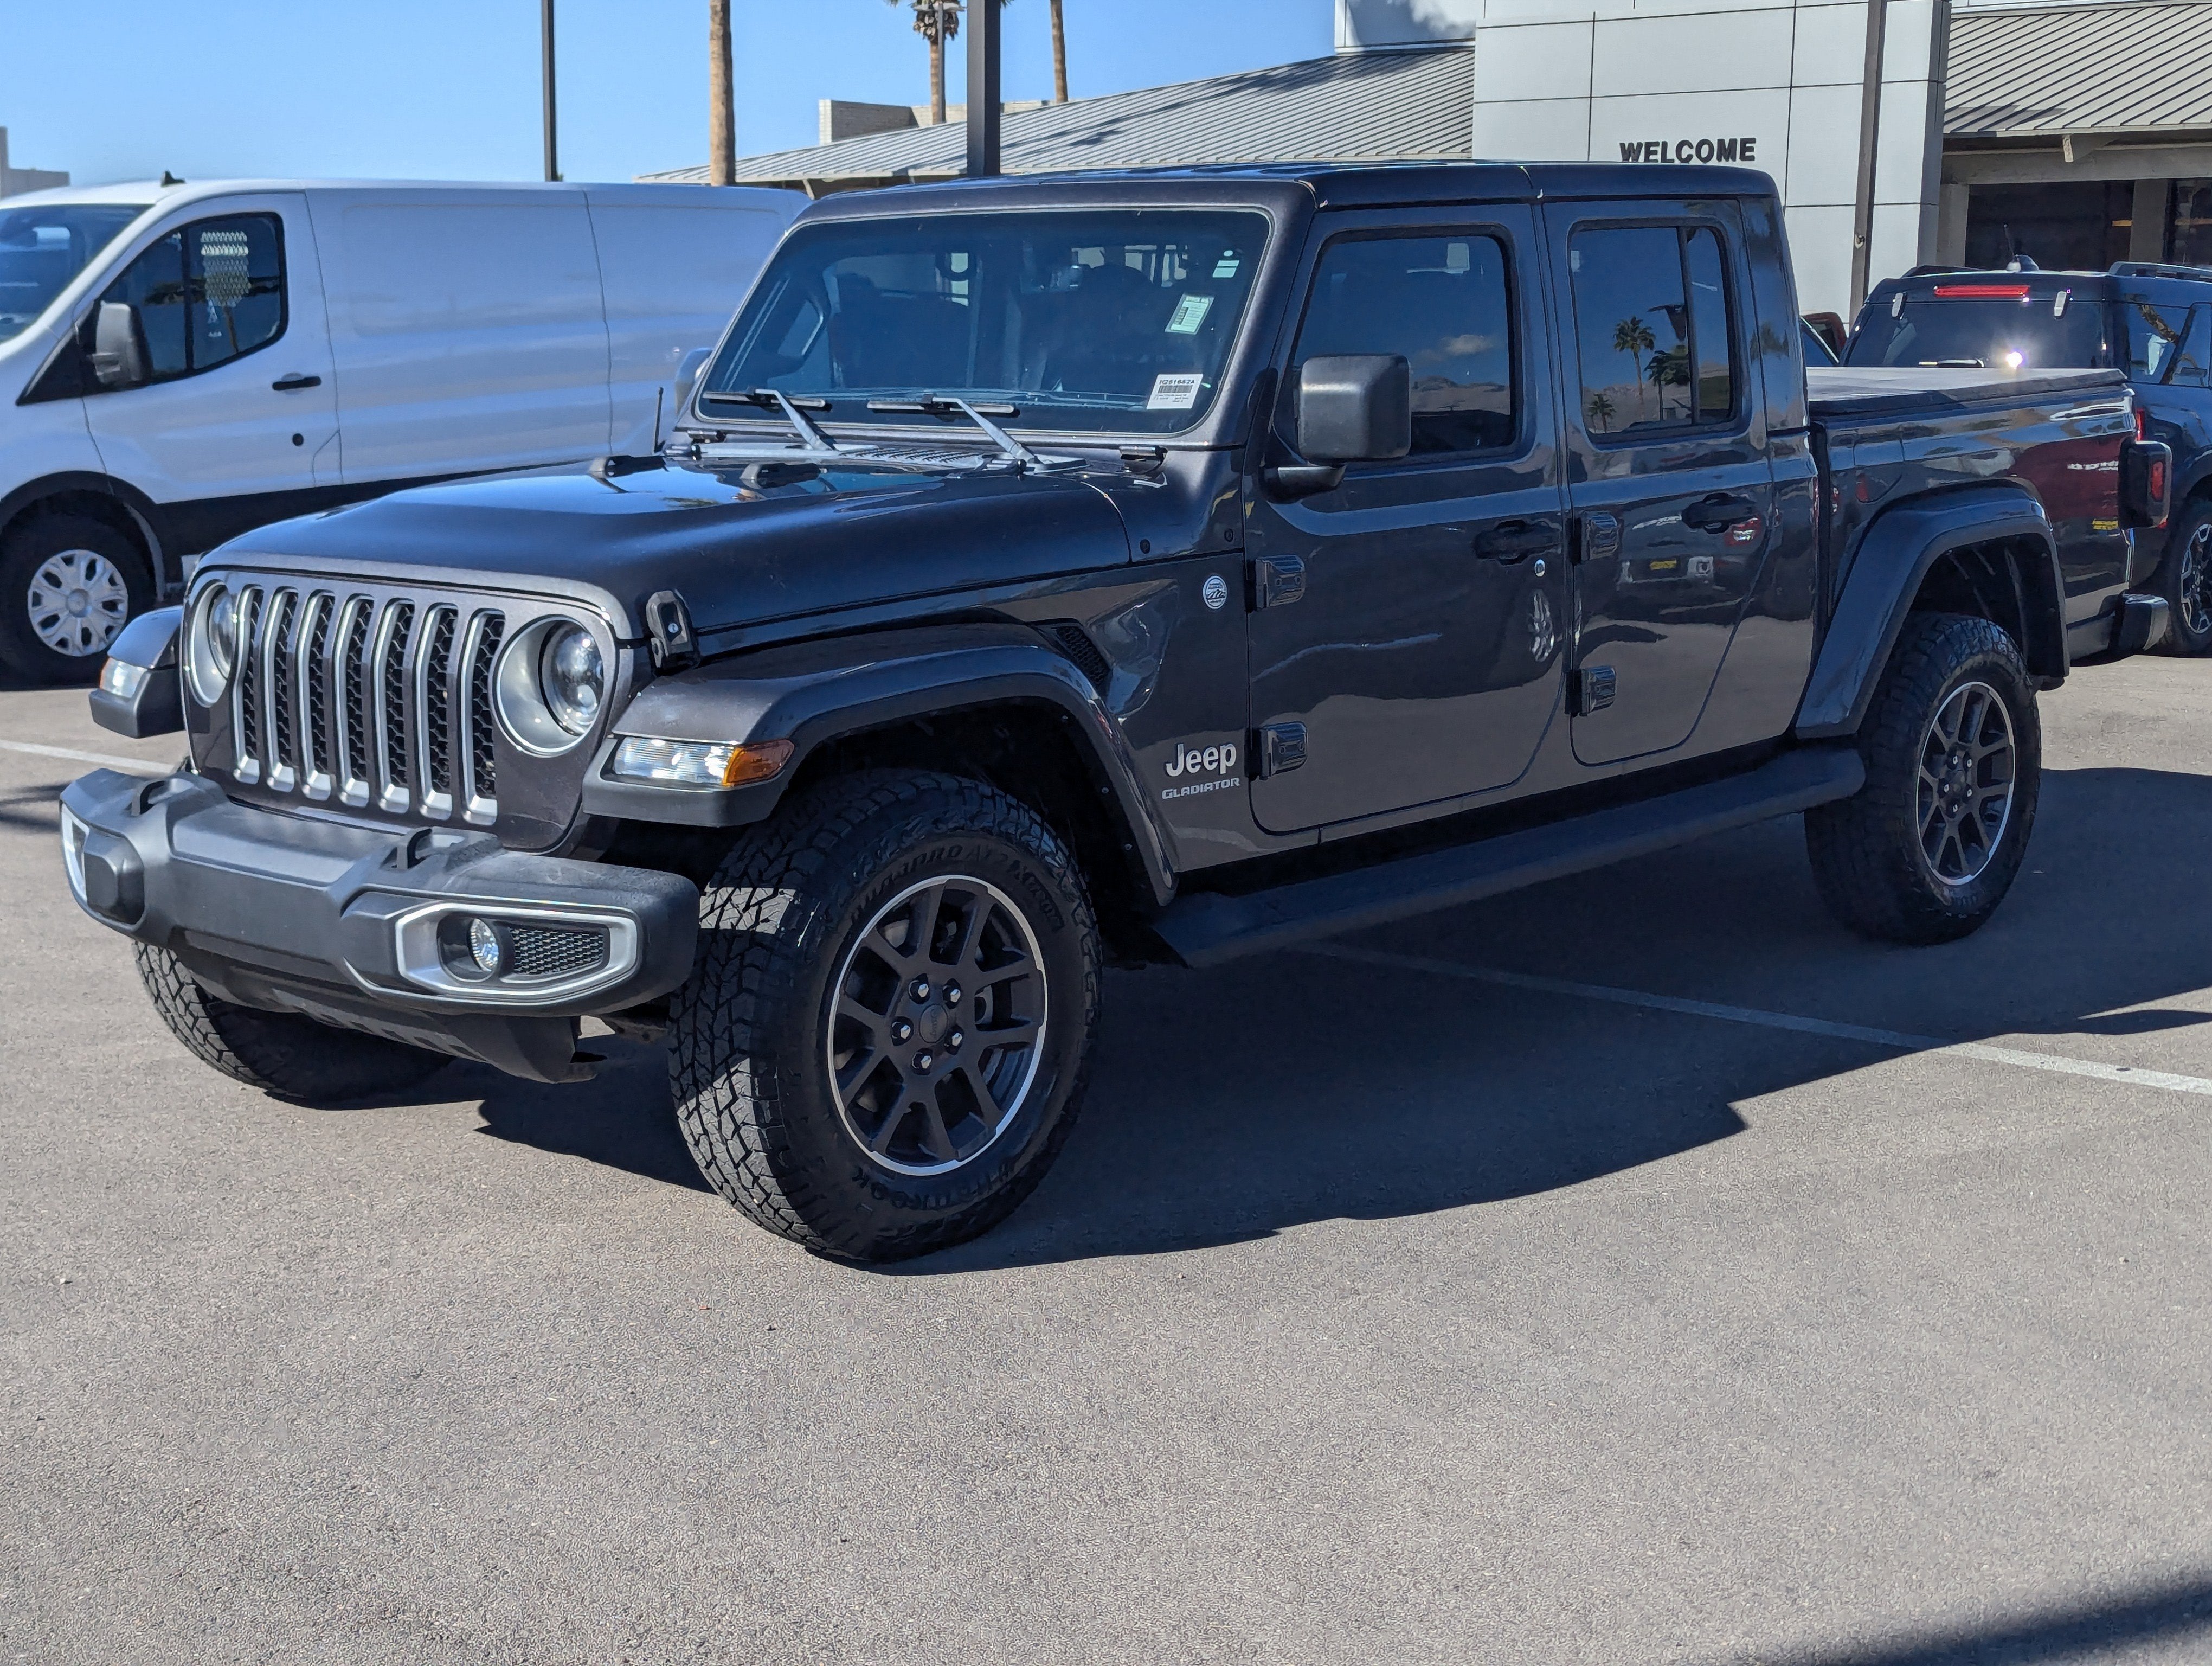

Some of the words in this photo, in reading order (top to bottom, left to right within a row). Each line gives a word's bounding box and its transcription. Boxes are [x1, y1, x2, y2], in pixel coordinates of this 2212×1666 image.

[1619, 137, 1757, 163] WELCOME
[1165, 743, 1237, 777] Jeep
[1162, 777, 1241, 800] GLADIATOR
